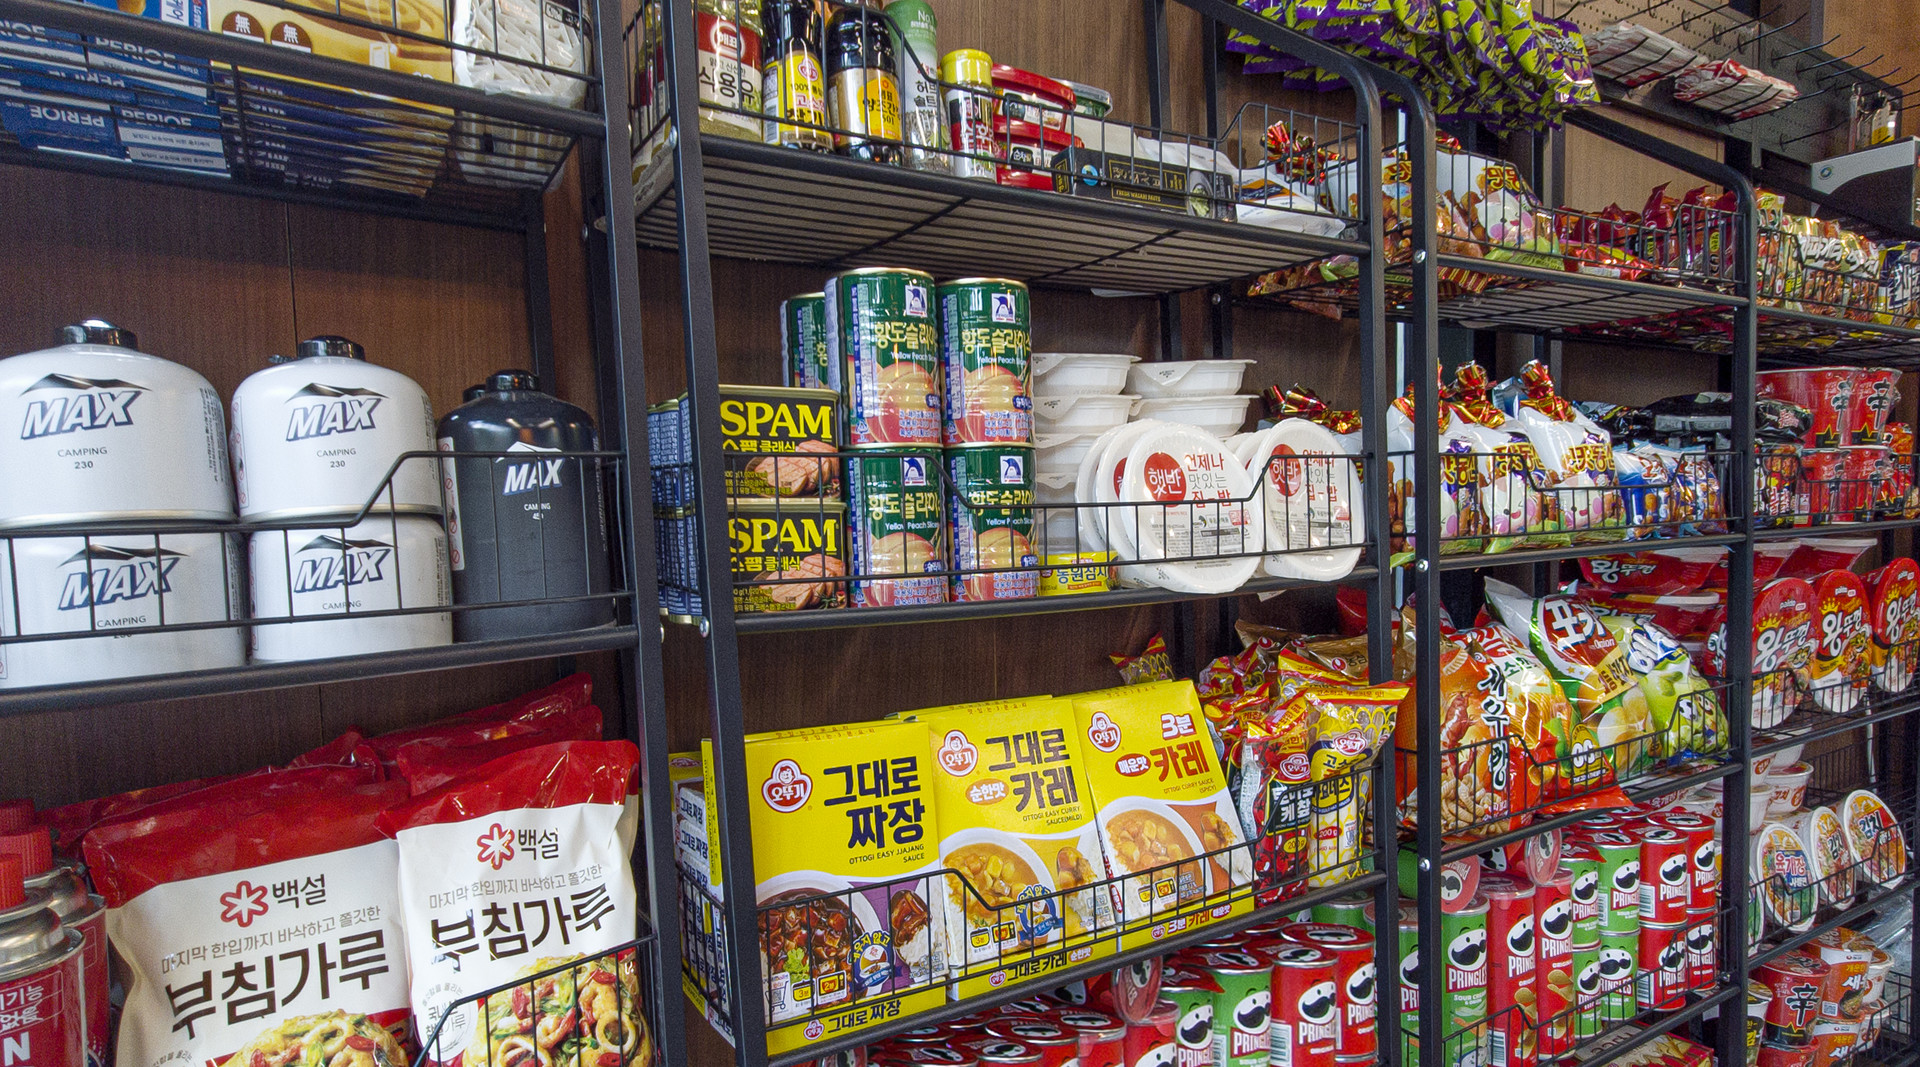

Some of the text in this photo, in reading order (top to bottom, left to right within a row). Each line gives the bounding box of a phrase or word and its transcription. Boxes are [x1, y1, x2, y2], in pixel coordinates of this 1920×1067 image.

[235, 13, 251, 33] 無
[283, 23, 298, 44] 無
[699, 66, 755, 106] 식용유
[21, 390, 142, 440] MAX
[286, 397, 382, 441] MAX
[720, 400, 832, 438] SPAM
[1867, 377, 1891, 430] 辛
[57, 446, 108, 457] CAMPING
[74, 460, 94, 469] 230
[316, 447, 356, 457] CAMPING
[330, 460, 345, 468] 230
[1184, 452, 1224, 471] 언제나
[503, 457, 564, 495] MAX
[1147, 467, 1182, 494] 햇반
[1188, 473, 1227, 489] 맛있는
[1272, 459, 1299, 486] 햇반
[728, 518, 837, 554] SPAM
[58, 557, 180, 610] MAX
[294, 547, 393, 593] MAX
[97, 615, 147, 628] CAMPING
[1821, 606, 1863, 658] 왕뚜껑
[1886, 590, 1917, 644] 왕뚜껑
[1753, 620, 1811, 673] 왕뚜껑
[1094, 729, 1118, 744] 오뚜기
[1162, 713, 1197, 740] 3분
[1477, 665, 1510, 790] 새우깡
[945, 752, 972, 766] 오뚜기
[985, 728, 1070, 772] 그대로
[1150, 740, 1209, 783] 카레
[823, 756, 921, 807] 그대로
[1117, 759, 1149, 776] 매운맛
[1199, 779, 1214, 787] SAUCE
[771, 783, 804, 801] 오뚜기
[969, 782, 1007, 802] 순한맛
[1009, 765, 1079, 813] 카레
[1200, 785, 1216, 794] (SPICY)
[846, 798, 925, 850] 짜장
[1022, 805, 1080, 822] OTTOGI EASY CURRY
[1859, 811, 1882, 839] 김치
[518, 828, 559, 860] 백설
[849, 844, 924, 864] OTTOGI EASY JJAJANG
[903, 853, 925, 864] SAUCE
[1776, 852, 1806, 875] 육개장
[272, 874, 326, 908] 백설
[429, 863, 602, 909] 마지막 한입까지 바삭하고 쫄깃한
[430, 883, 615, 974] 부침가루
[1168, 904, 1232, 934] 3분 카레 매운맛
[162, 905, 381, 974] 마지막 한입까지 바삭하고 쫄깃한
[1007, 947, 1093, 981] 그대로 카레 순한맛
[165, 929, 389, 1040] 부침가루
[827, 1000, 901, 1033] 그대로 짜장
[1785, 983, 1820, 1026] 辛
